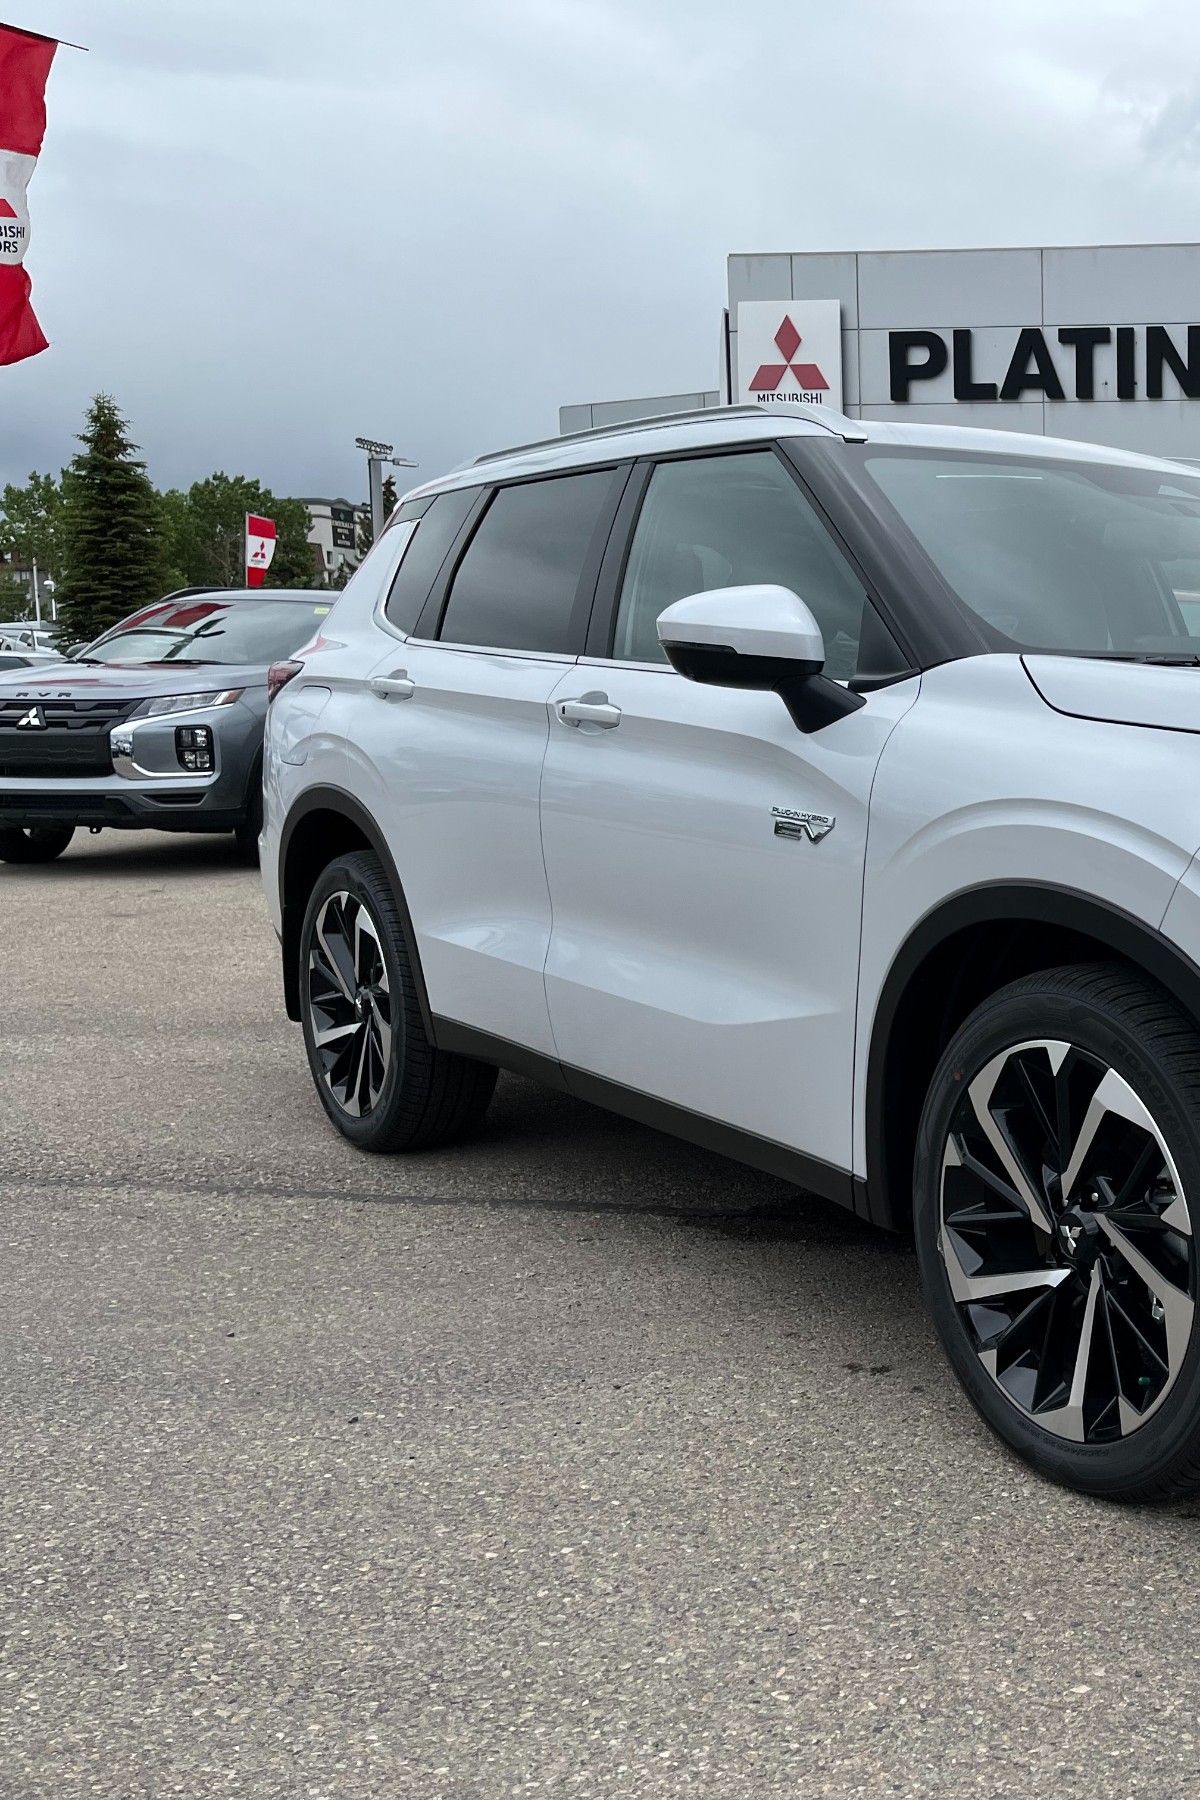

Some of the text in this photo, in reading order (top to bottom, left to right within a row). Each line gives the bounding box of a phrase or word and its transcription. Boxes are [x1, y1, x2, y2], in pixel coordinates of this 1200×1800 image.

[757, 392, 823, 404] MITSUBISHI
[772, 806, 828, 823] PLUG-IN HYBRID
